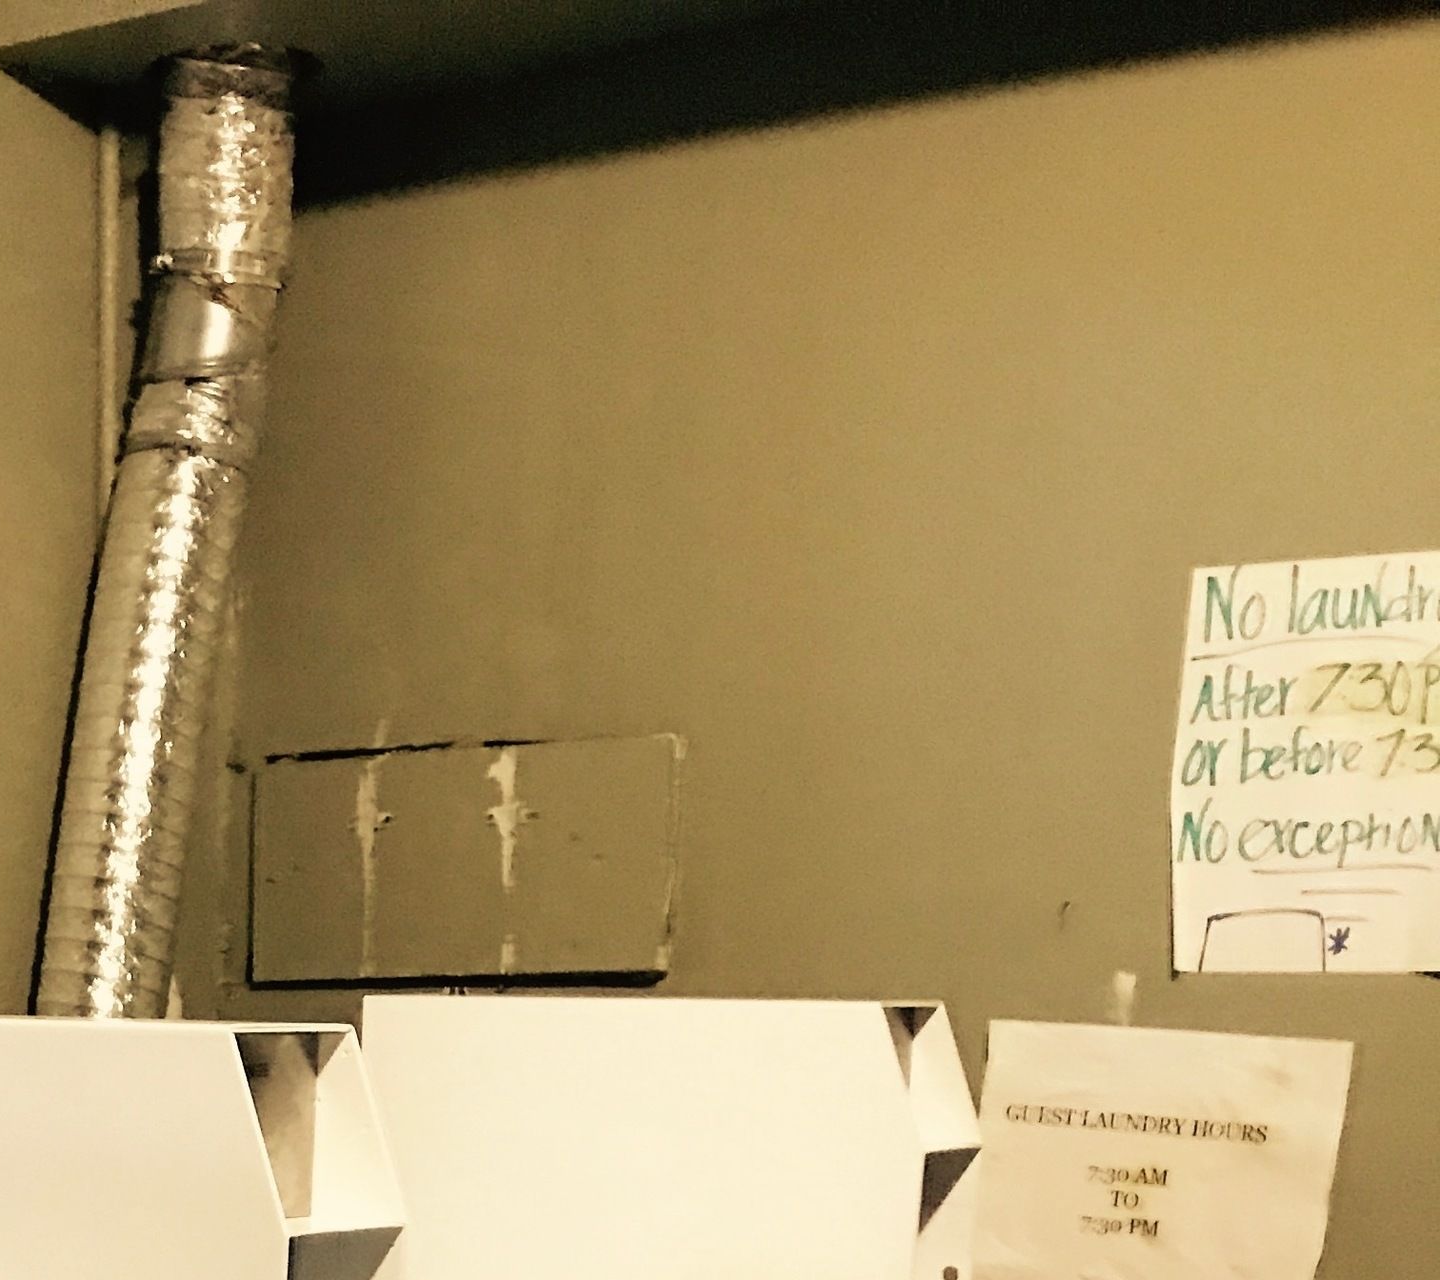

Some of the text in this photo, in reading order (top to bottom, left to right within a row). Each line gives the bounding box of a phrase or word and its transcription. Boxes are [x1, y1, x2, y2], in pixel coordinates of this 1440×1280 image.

[1204, 562, 1440, 643] No laundr
[1189, 663, 1299, 725] After
[1180, 737, 1228, 787] or
[1239, 724, 1362, 785] before
[1176, 797, 1440, 869] No exception
[1005, 1103, 1269, 1145] GUEST LAUNDRY HOURS
[1087, 1164, 1169, 1187] 7:30 AM
[1110, 1189, 1140, 1209] TO
[1079, 1215, 1160, 1238] 7:30 PM
